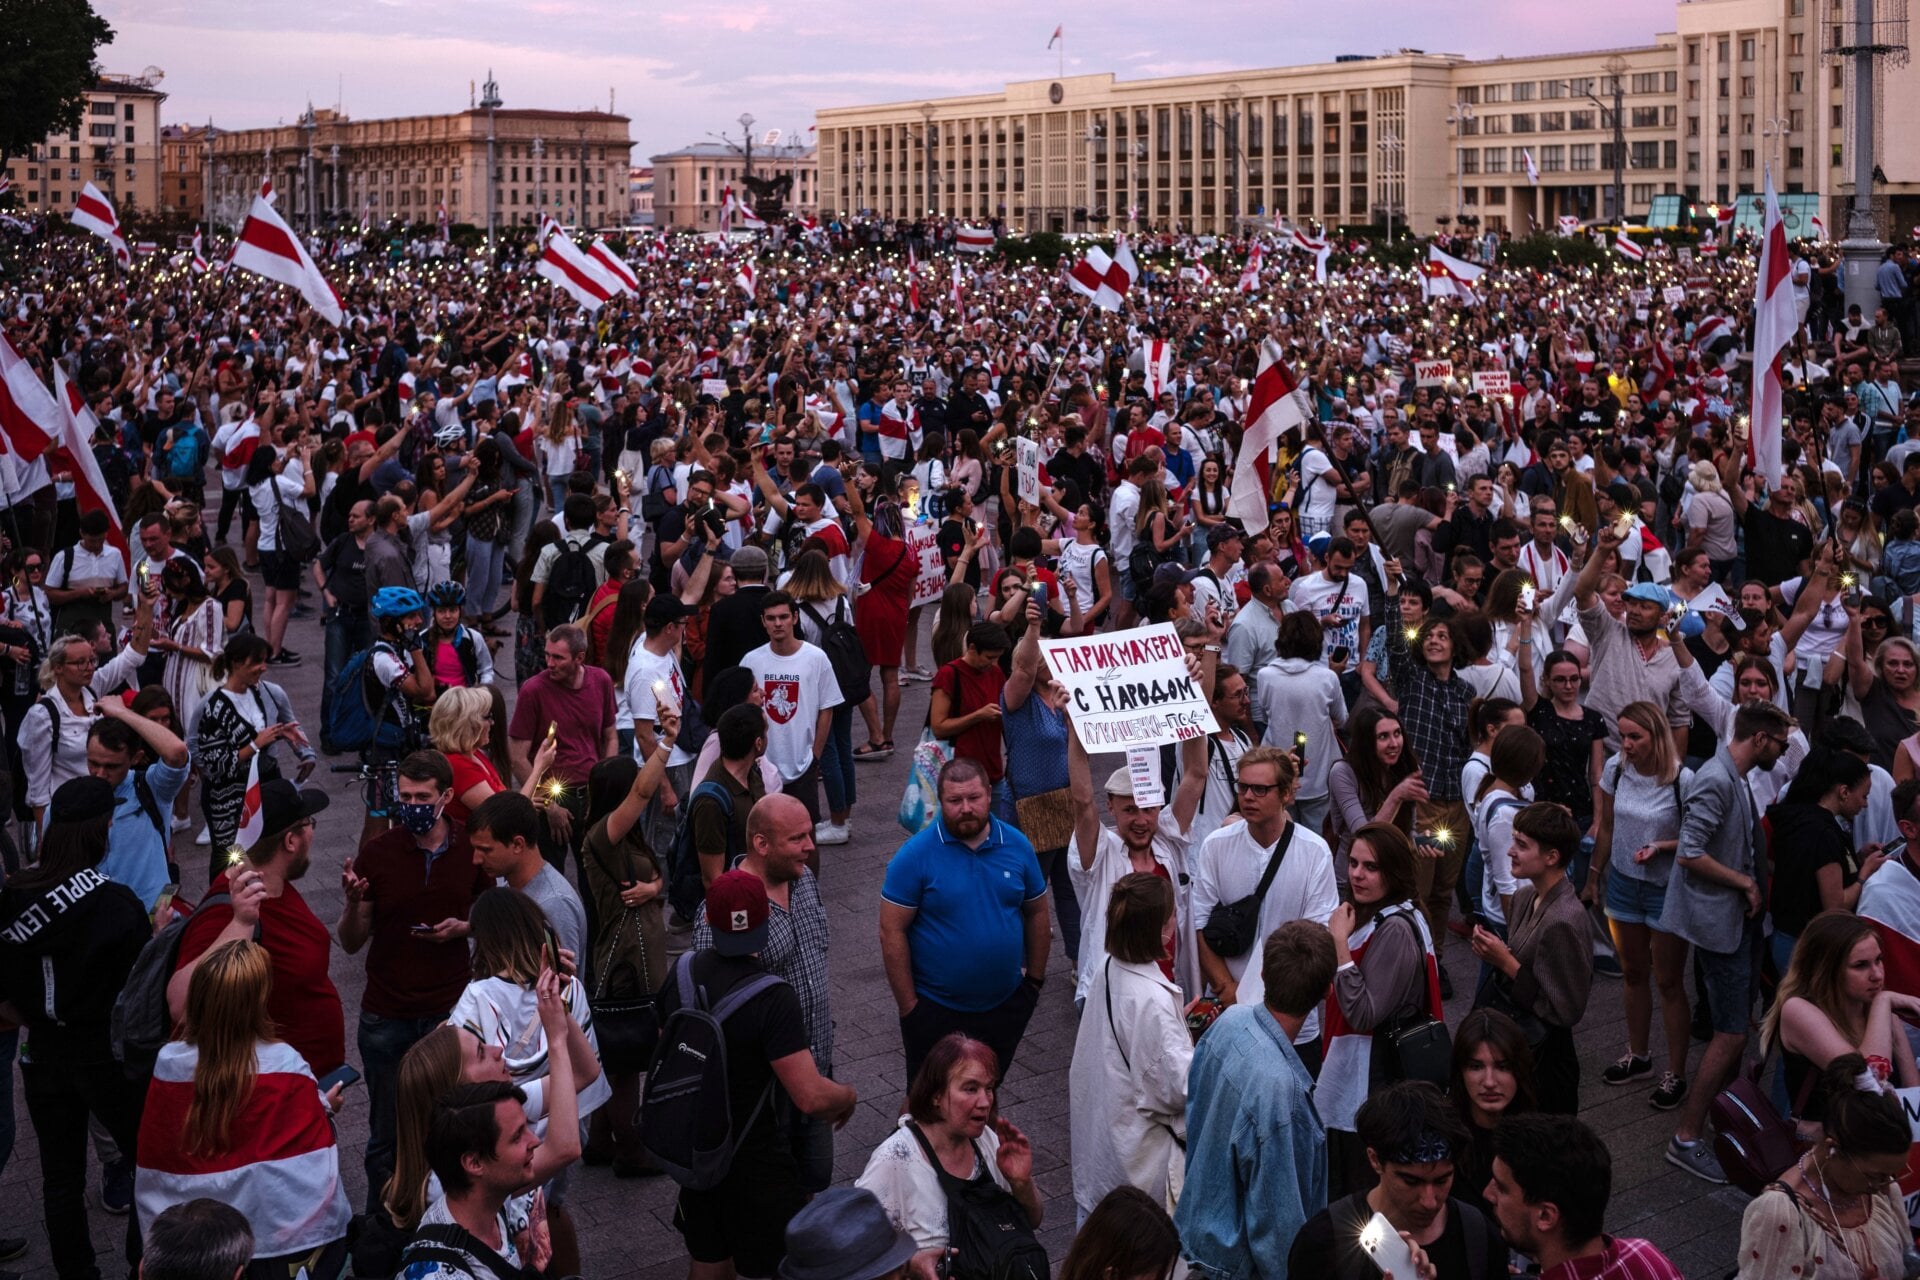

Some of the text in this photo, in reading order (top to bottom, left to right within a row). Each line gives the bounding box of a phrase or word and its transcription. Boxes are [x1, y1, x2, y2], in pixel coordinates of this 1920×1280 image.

[1050, 633, 1183, 674] ПАРИКМАХЕРЫ
[764, 673, 800, 681] BELARUS
[1074, 676, 1198, 712] С НАРОДОМ
